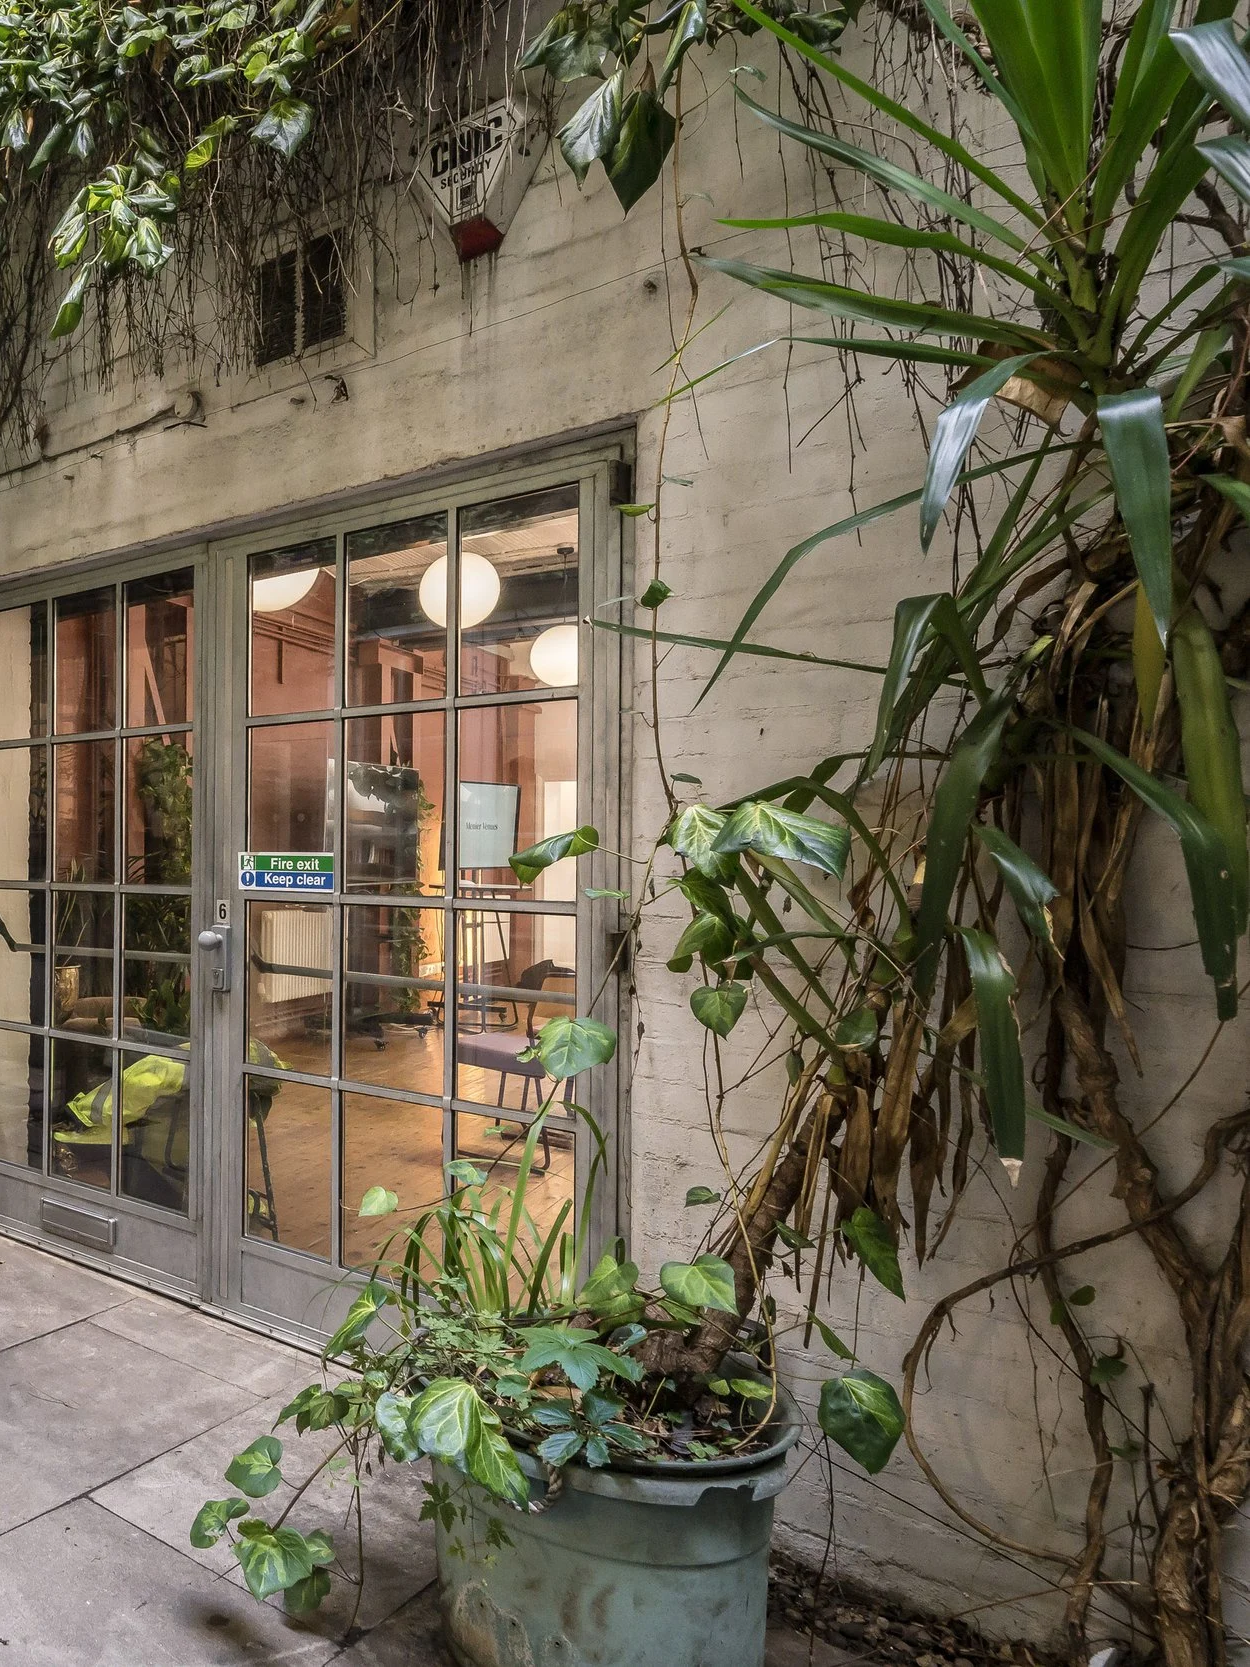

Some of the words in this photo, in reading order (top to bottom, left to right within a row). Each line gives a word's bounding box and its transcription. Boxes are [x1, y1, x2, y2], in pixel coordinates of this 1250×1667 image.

[270, 858, 294, 870] Fire
[296, 858, 320, 870] exit
[264, 873, 294, 887] Keep
[296, 874, 326, 886] clear
[219, 903, 227, 919] 6
